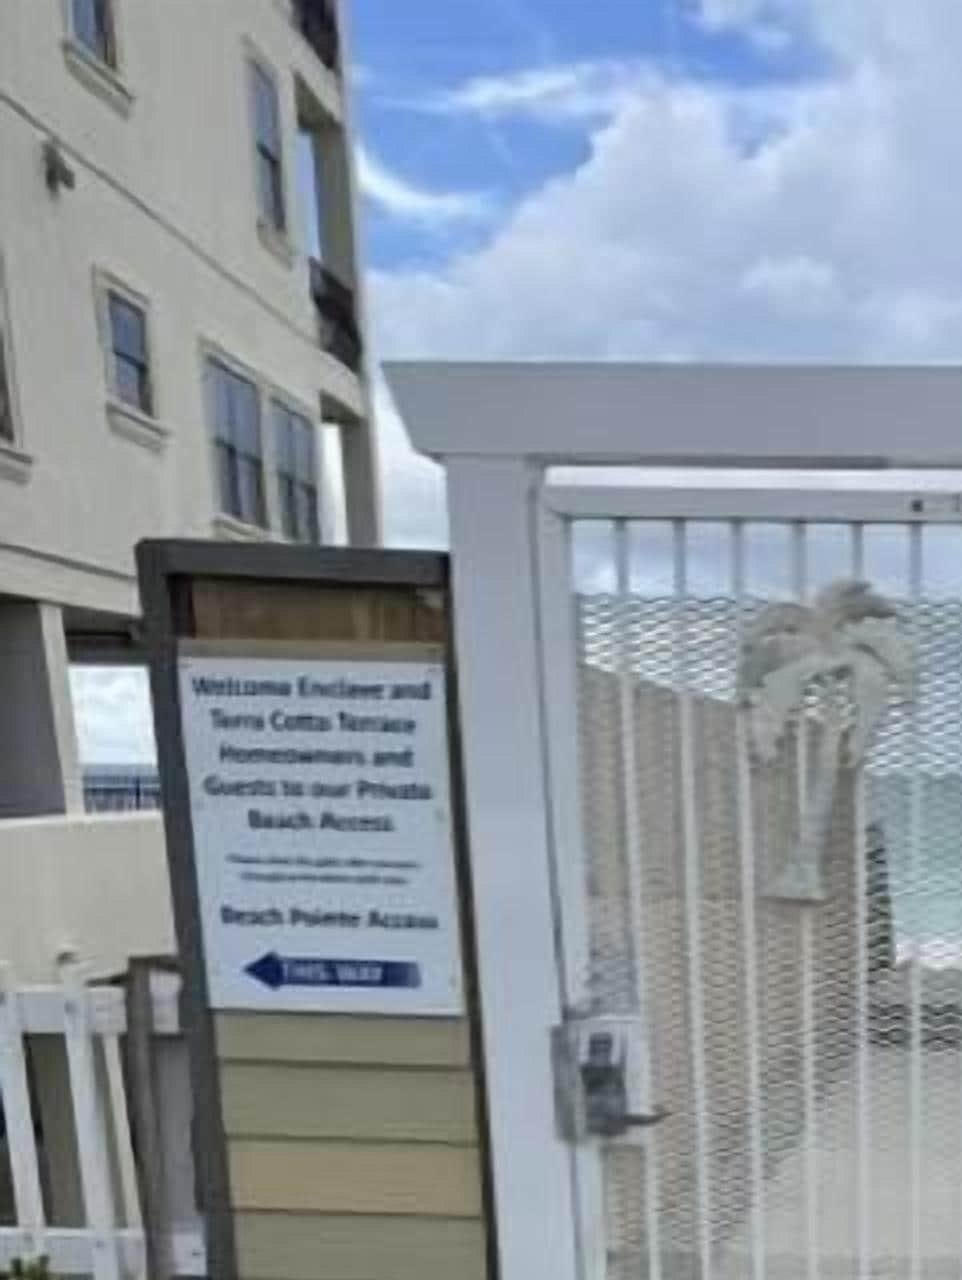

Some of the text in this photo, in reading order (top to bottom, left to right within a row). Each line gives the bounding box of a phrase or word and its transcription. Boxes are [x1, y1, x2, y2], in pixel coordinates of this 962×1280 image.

[192, 676, 431, 700] Welcome Enclave and
[210, 709, 416, 732] Terra Cotta Terrace
[219, 743, 413, 767] Homeowners and
[204, 775, 276, 795] Guests
[282, 780, 303, 796] to
[311, 784, 350, 797] our
[248, 809, 393, 832] Beach Access
[221, 905, 283, 924] Beach
[367, 910, 438, 928] Access
